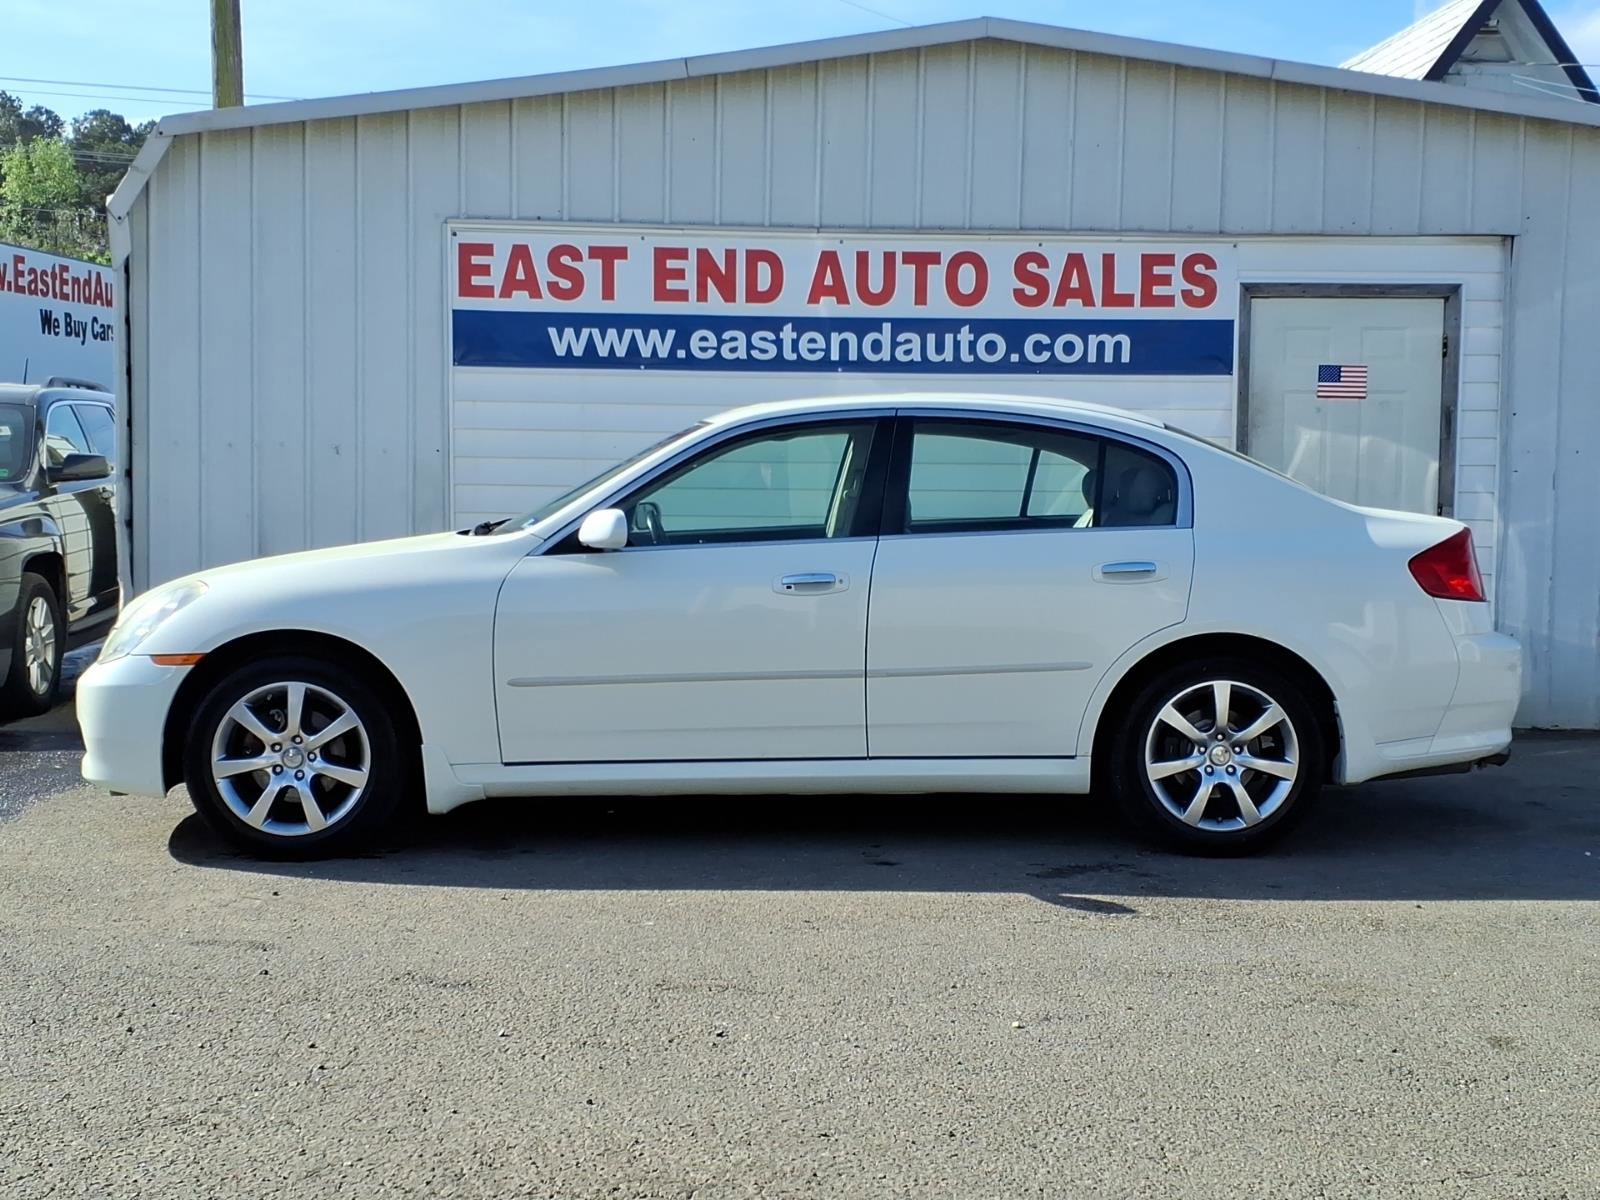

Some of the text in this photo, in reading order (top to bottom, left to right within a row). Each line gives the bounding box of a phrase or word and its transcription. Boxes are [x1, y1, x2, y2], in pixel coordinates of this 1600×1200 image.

[458, 243, 1218, 308] EAST END AUTO SALES
[40, 308, 60, 337] We
[64, 312, 87, 346] Buy
[547, 322, 1132, 364] www.eastendauto.com
